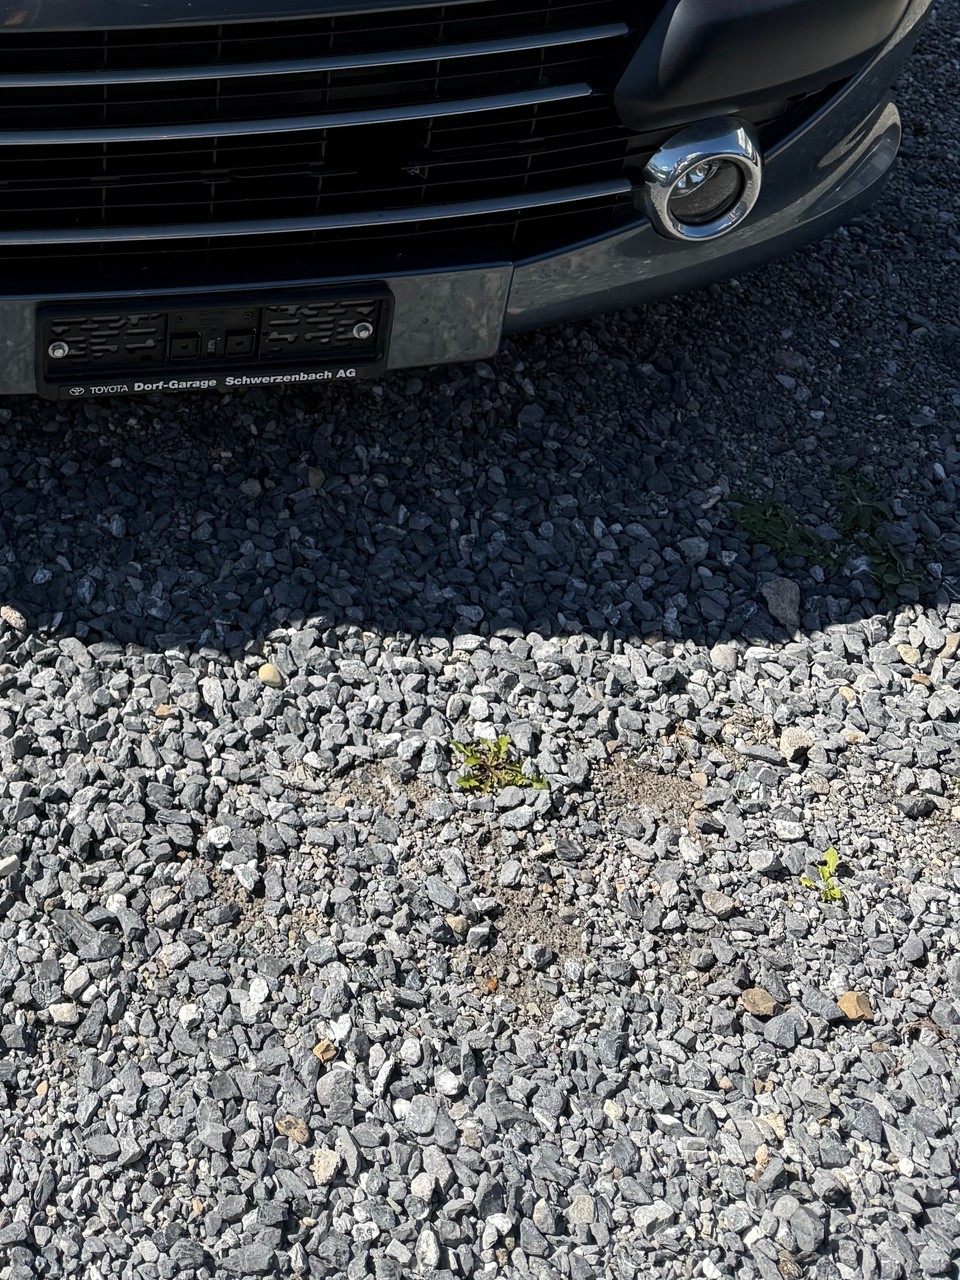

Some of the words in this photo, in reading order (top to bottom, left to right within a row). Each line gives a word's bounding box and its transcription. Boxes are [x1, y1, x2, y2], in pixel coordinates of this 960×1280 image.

[90, 384, 129, 394] TOYOTA
[134, 379, 217, 391] Dorf-Garage
[225, 370, 332, 386] Schwerzenbach
[336, 368, 356, 379] AG
